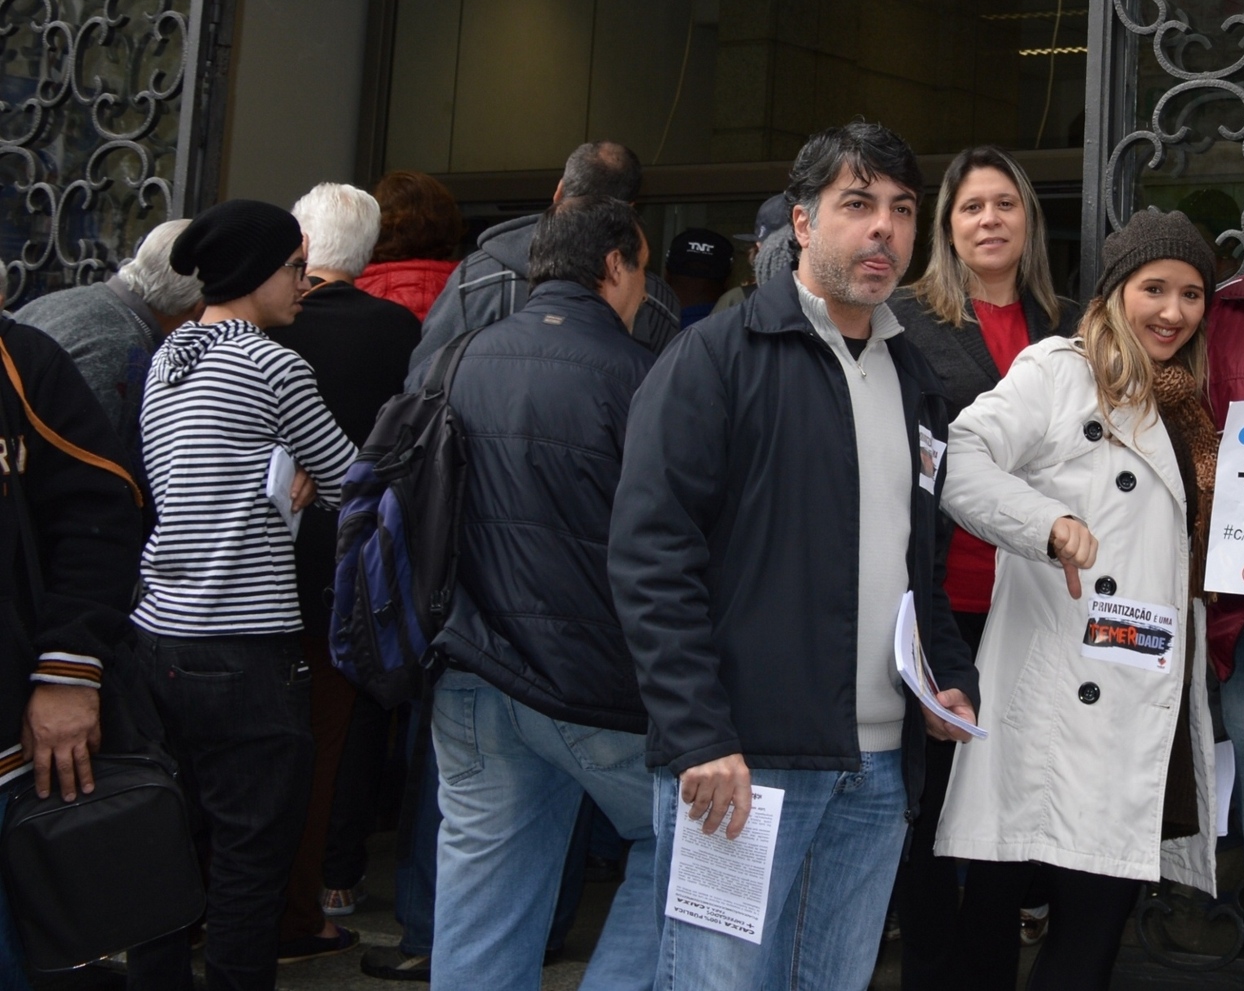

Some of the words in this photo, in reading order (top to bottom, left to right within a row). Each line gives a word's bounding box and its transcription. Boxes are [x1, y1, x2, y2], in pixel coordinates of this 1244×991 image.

[688, 241, 714, 252] TNT
[1092, 600, 1152, 621] PRIVATIZAÇÃO
[1158, 616, 1173, 626] UMA
[1089, 623, 1166, 650] TEMERIDADE
[676, 897, 705, 909] CAIXA
[724, 921, 755, 935] CAIXA
